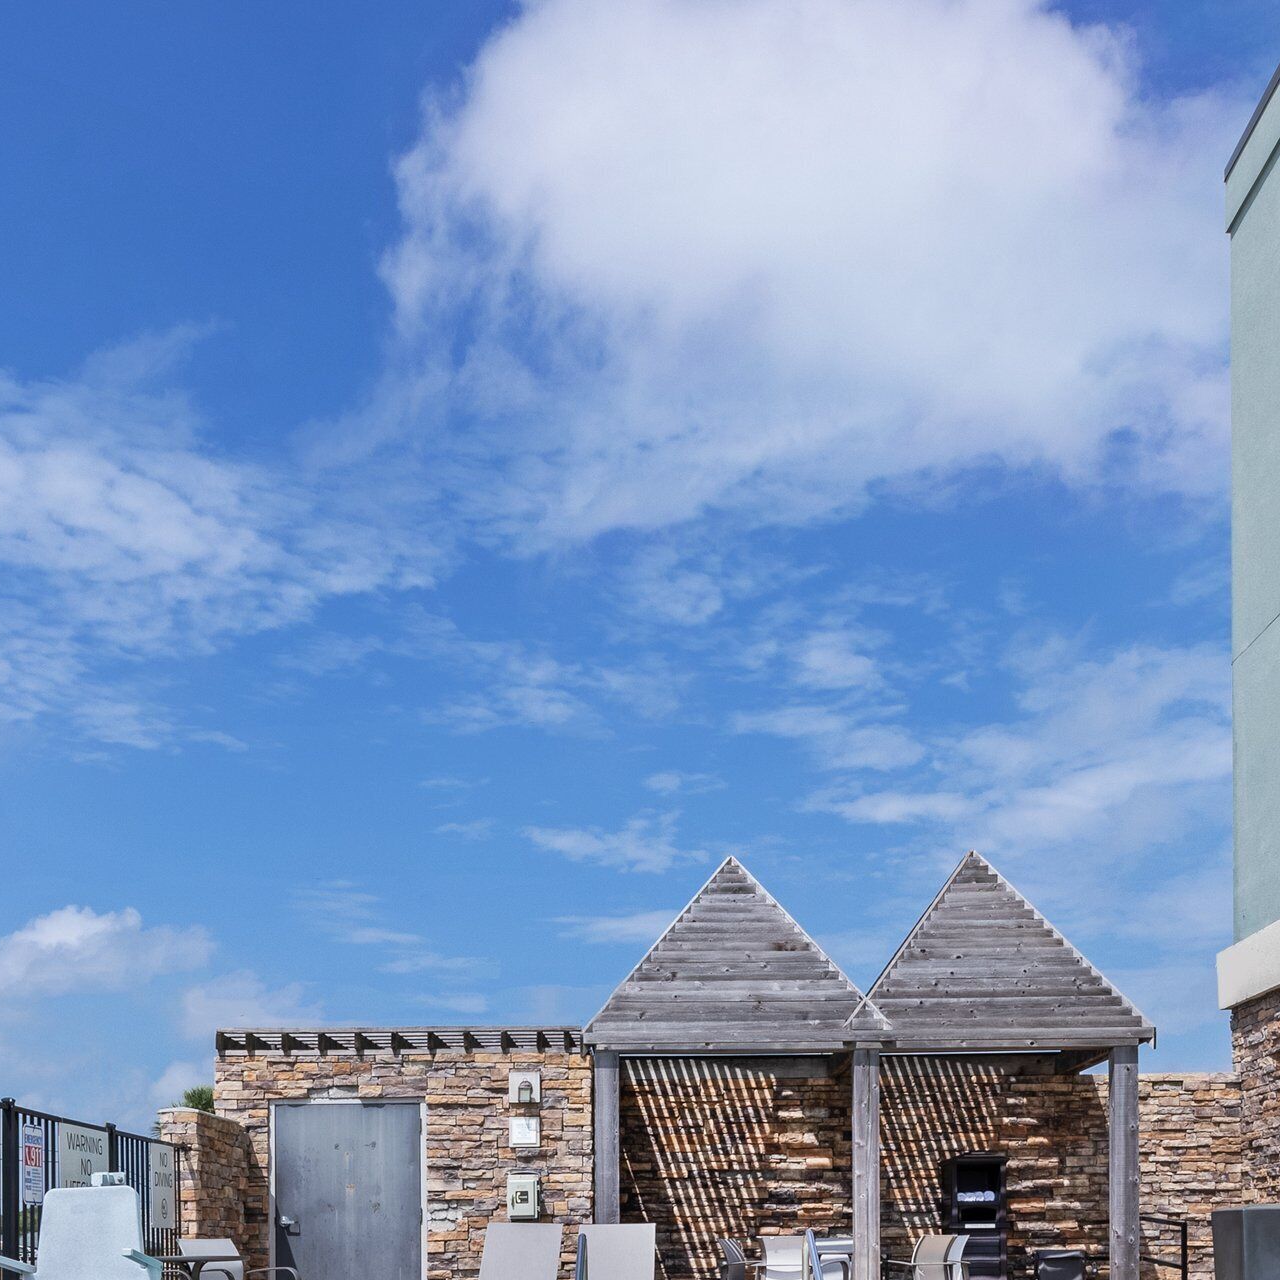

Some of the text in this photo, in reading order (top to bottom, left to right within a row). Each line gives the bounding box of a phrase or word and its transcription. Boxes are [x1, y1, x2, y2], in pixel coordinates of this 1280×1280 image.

[66, 1131, 103, 1155] WARNING
[30, 1147, 42, 1167] 911
[160, 1152, 168, 1168] NO
[80, 1158, 93, 1176] NO
[154, 1171, 173, 1188] DIVING
